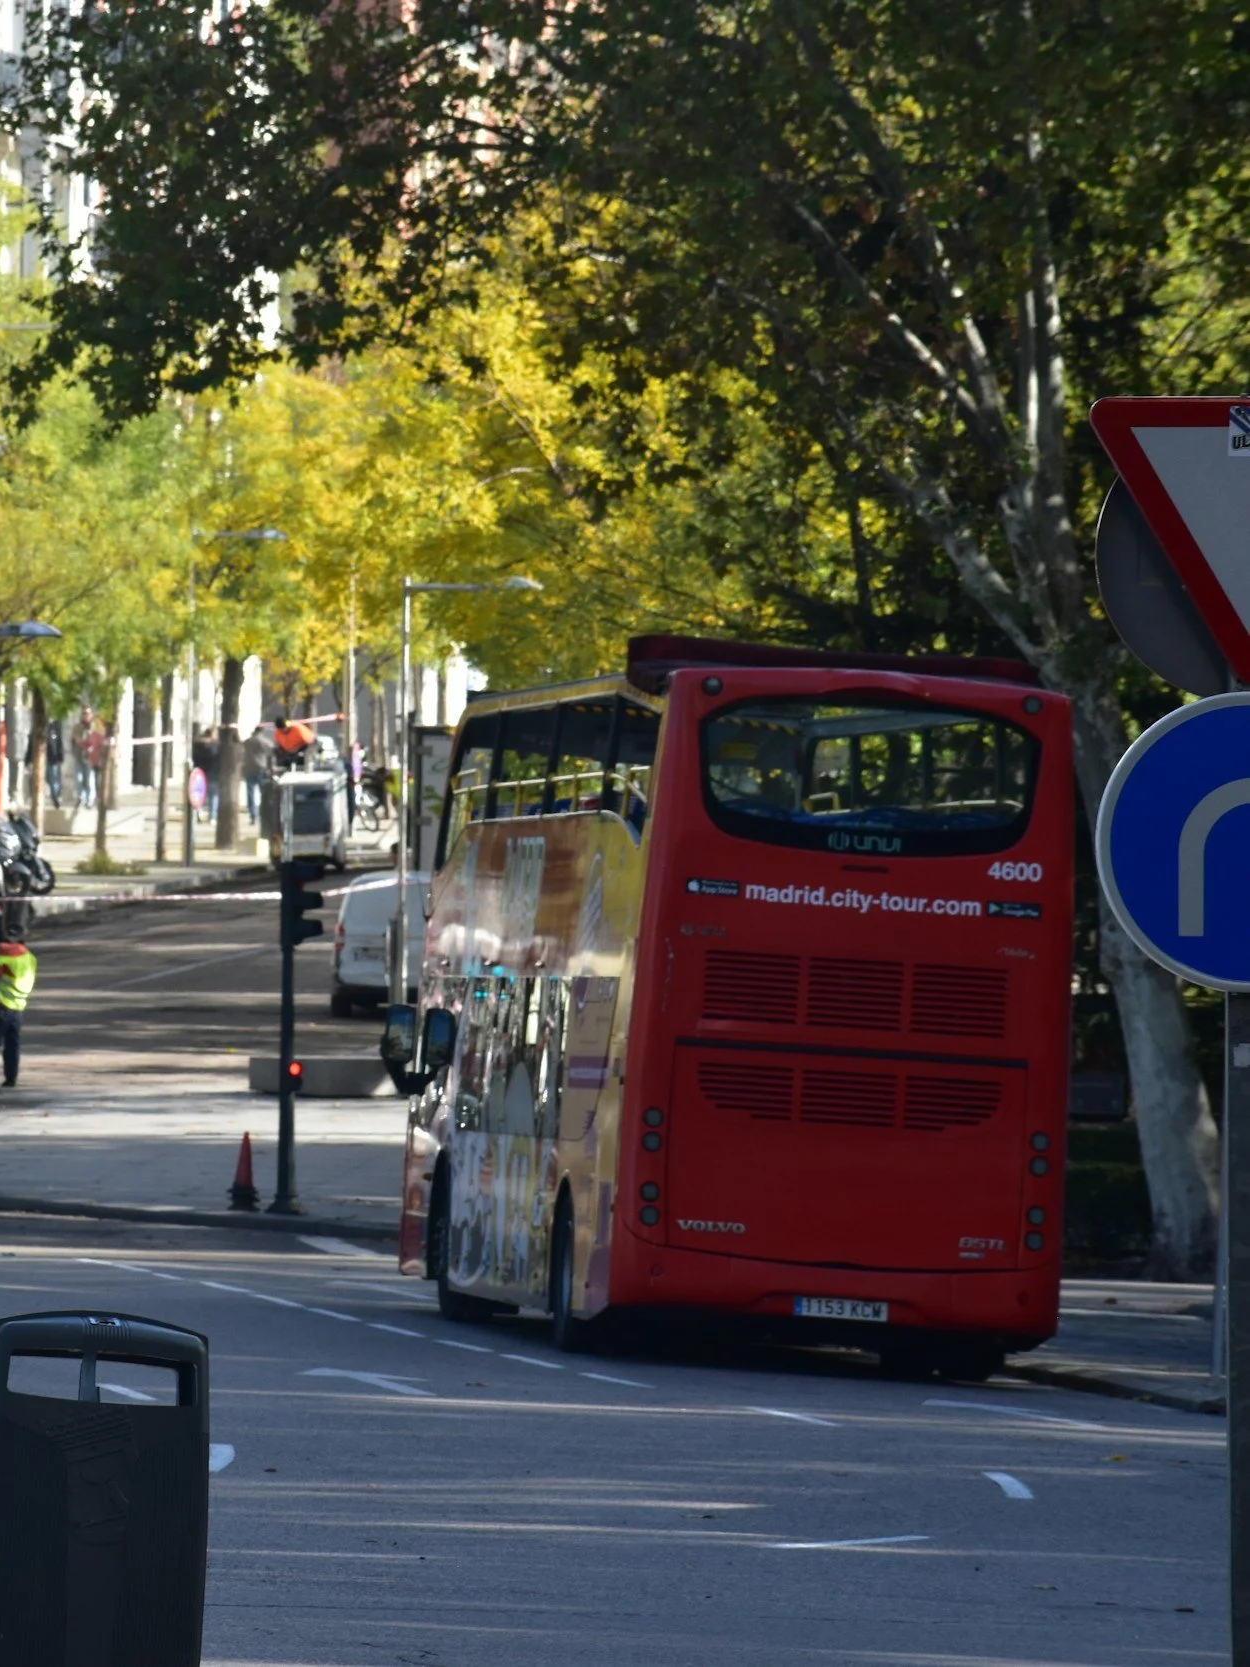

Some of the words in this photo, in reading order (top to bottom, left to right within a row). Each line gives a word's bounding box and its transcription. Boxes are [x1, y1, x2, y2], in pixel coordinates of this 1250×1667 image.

[987, 861, 1043, 882] 4600
[745, 882, 982, 917] madrid.city-tour.com
[676, 1218, 747, 1234] VOLVO
[805, 1298, 845, 1316] 1153
[850, 1301, 883, 1319] KCW
